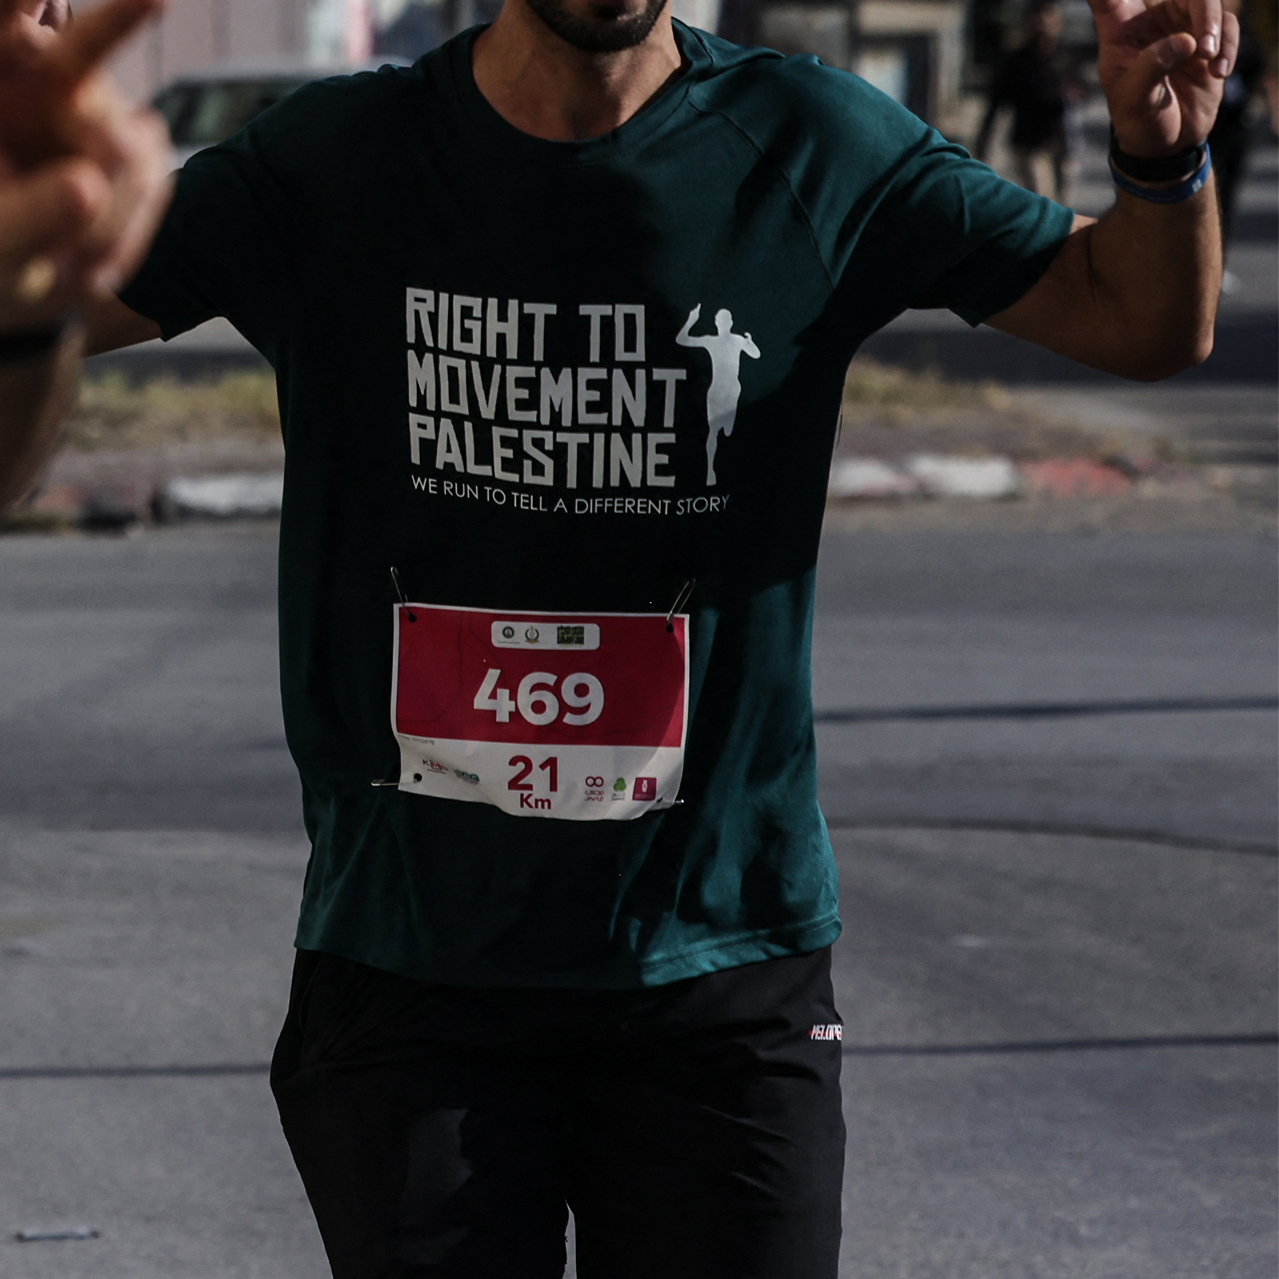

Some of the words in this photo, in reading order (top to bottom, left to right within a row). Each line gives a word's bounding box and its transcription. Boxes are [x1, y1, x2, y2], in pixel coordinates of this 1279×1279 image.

[406, 287, 557, 362] RIGHT
[579, 303, 646, 363] TO
[407, 350, 687, 428] MOVEMENT
[408, 412, 677, 489] PALESTINE
[411, 475, 437, 494] WE
[443, 481, 479, 501] RUN
[484, 486, 506, 505] TO
[511, 492, 548, 512] TELL
[553, 498, 568, 513] A
[575, 498, 671, 515] DIFFERENT
[676, 494, 731, 516] STORY
[473, 668, 605, 726] 469
[507, 755, 558, 793] 21
[519, 793, 552, 810] Km
